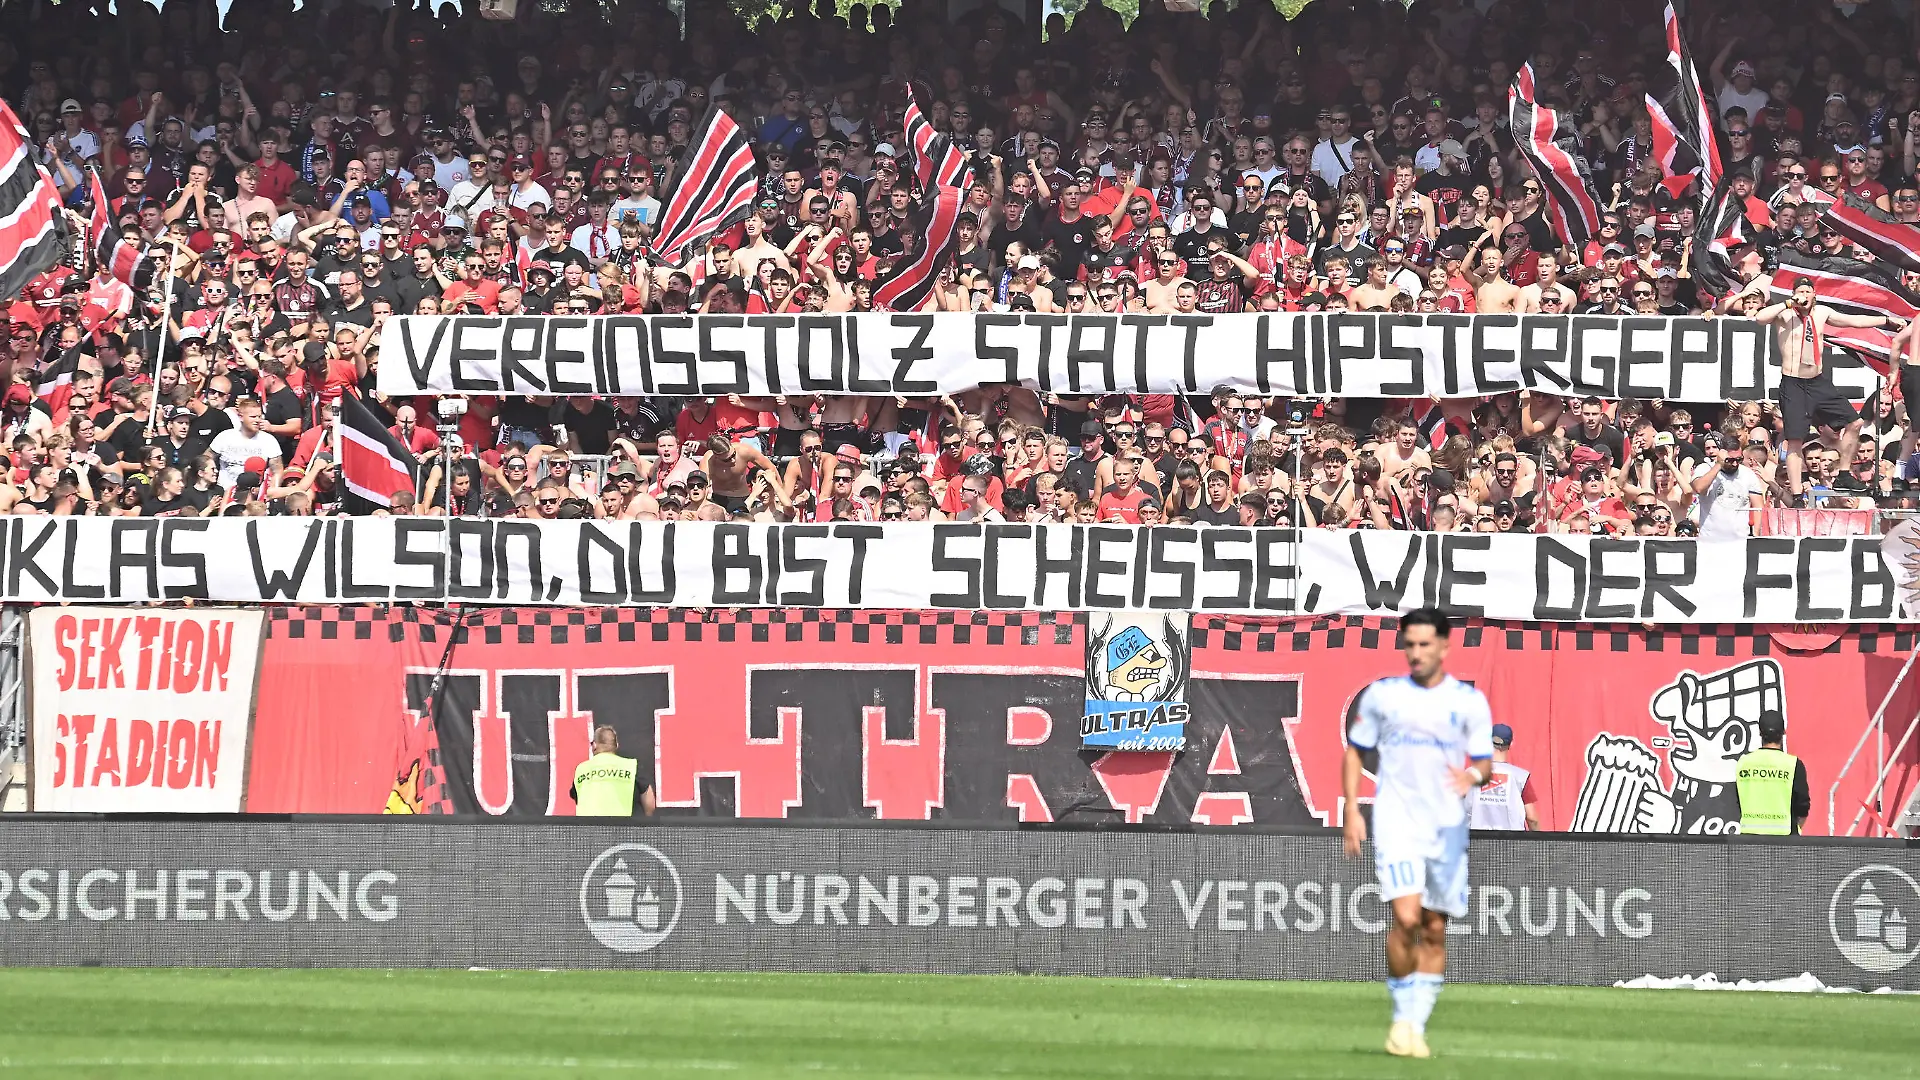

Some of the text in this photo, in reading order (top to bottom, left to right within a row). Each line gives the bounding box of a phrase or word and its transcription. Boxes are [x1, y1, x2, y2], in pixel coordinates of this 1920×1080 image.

[400, 315, 937, 394] VEREINSSTOLZ
[975, 314, 1214, 394] STATT
[246, 519, 562, 602] WILSON,
[577, 521, 676, 604] DU
[712, 523, 884, 606] BIST
[930, 524, 1322, 613] SCHEISSE,
[1349, 532, 1491, 617] WIE
[1533, 536, 1698, 620] DER
[54, 614, 234, 694] SEKTION
[53, 713, 222, 789] STADION
[404, 664, 1475, 825] ULTRA
[1080, 702, 1191, 737] ULTRAS
[1116, 735, 1187, 751] seit 2002
[591, 769, 631, 779] POWER
[1752, 769, 1790, 780] POWER
[714, 872, 1148, 930] NÜRNBERGER
[1170, 879, 1653, 938] VERSICRUNG
[1388, 860, 1415, 889] 10
